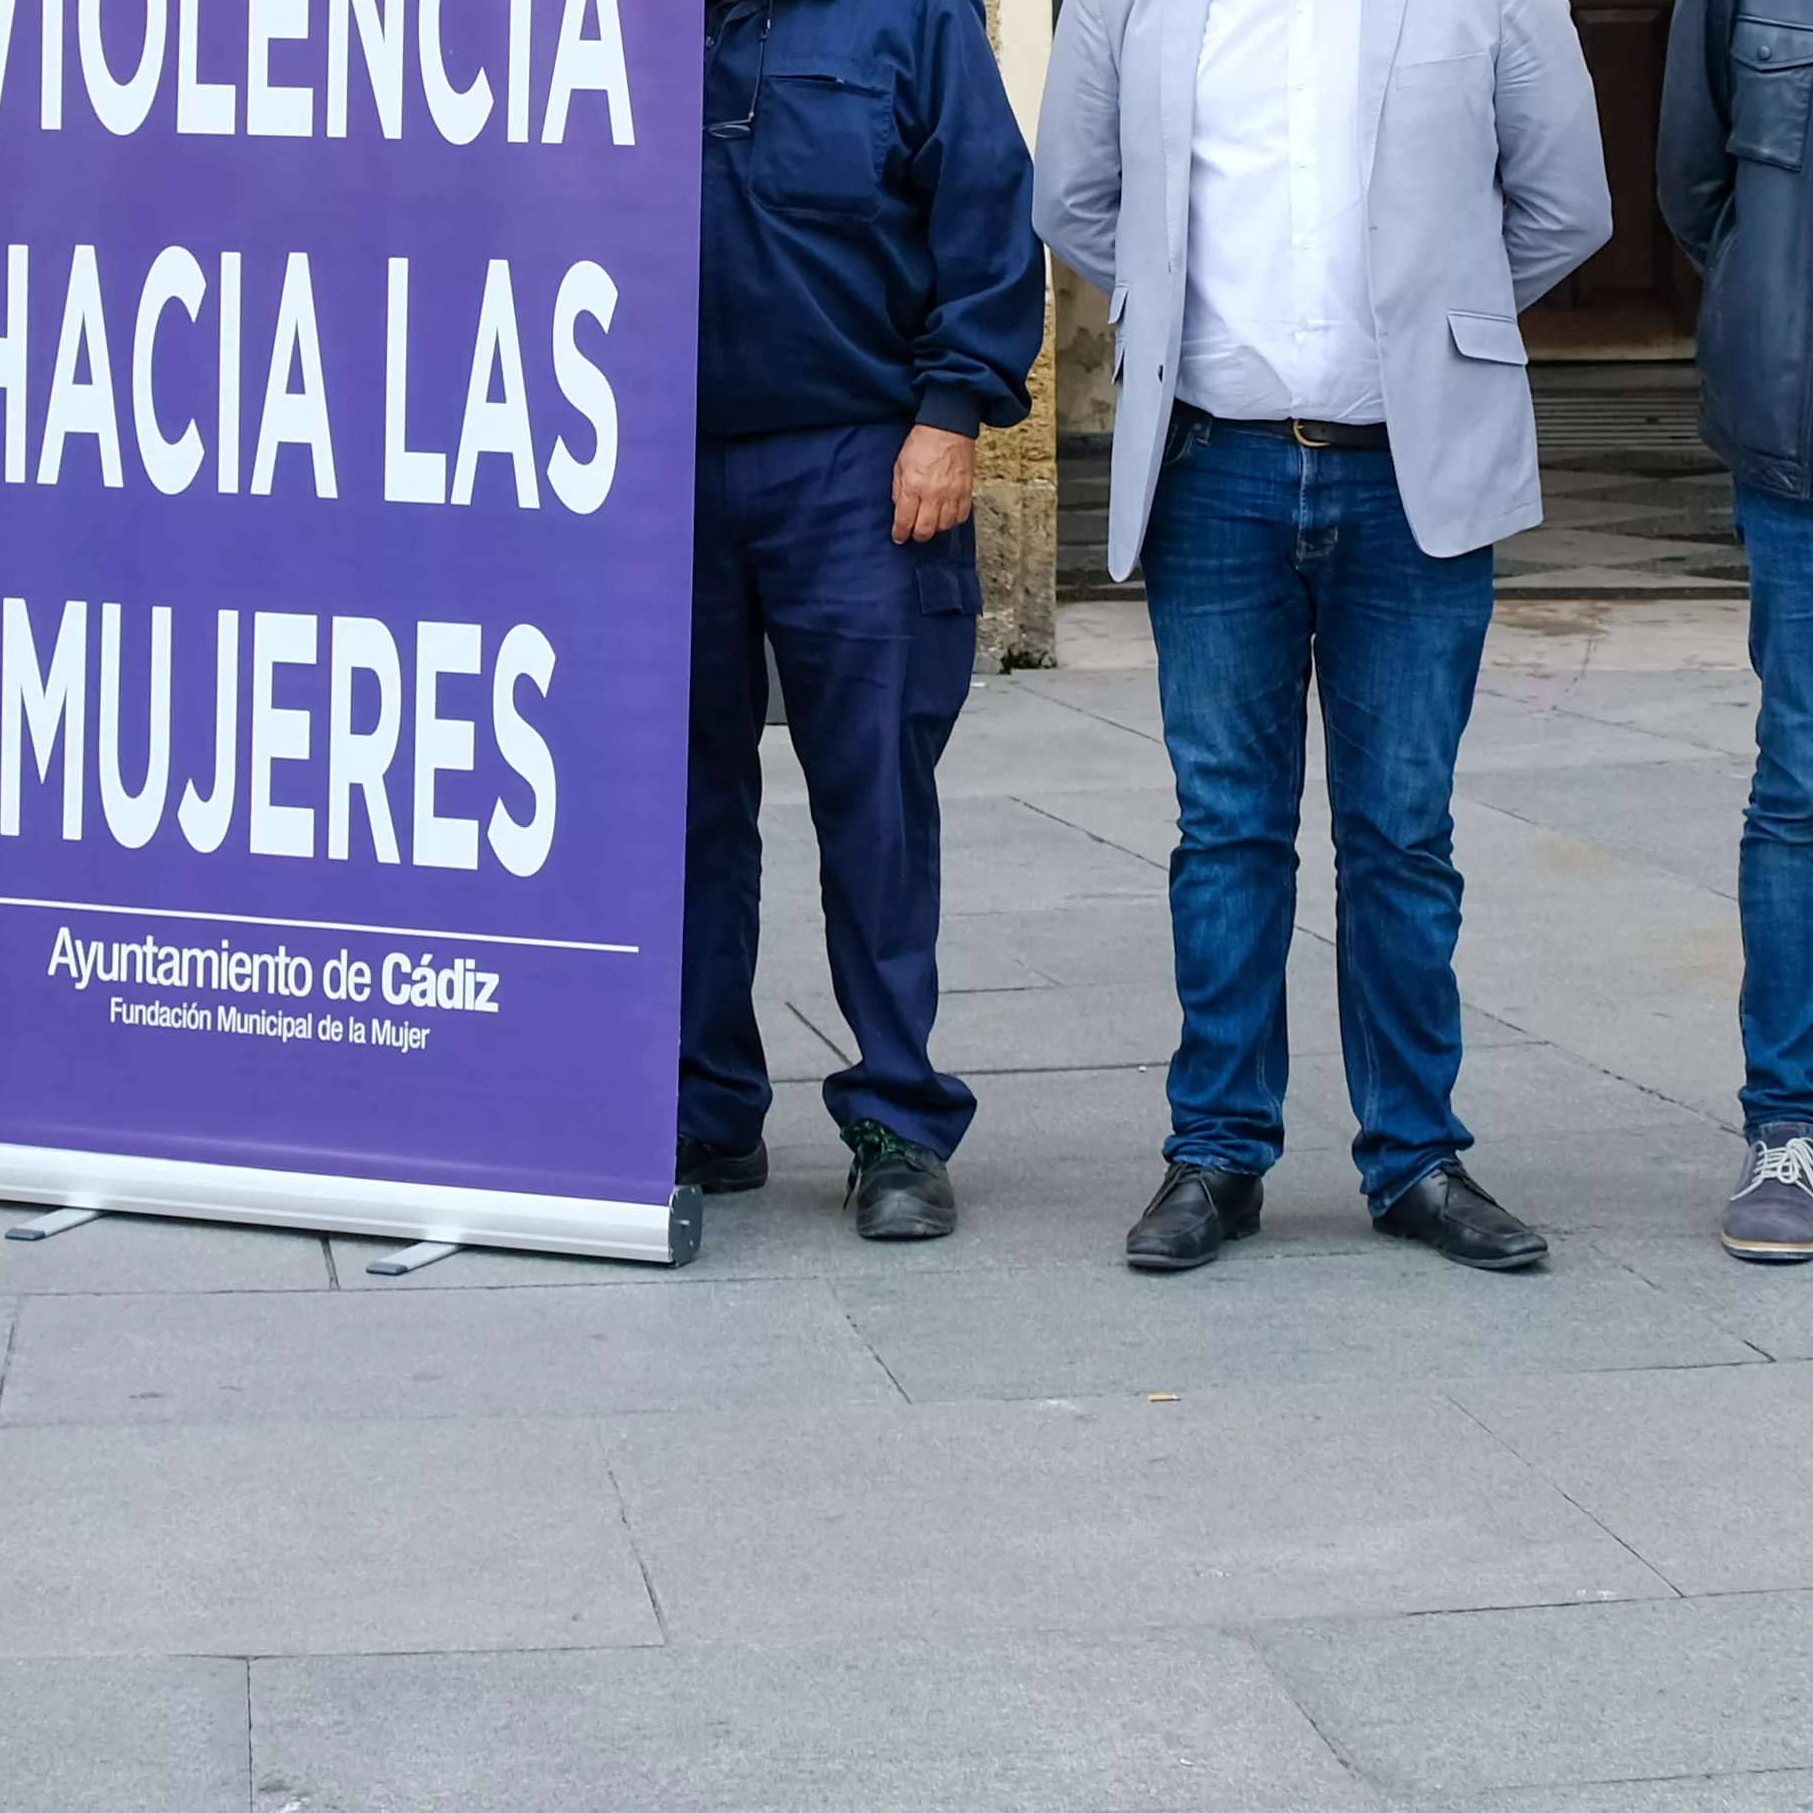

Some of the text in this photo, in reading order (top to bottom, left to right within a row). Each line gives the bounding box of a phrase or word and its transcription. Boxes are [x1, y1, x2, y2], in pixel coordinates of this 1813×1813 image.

[384, 257, 619, 515] LAS
[0, 597, 557, 877] MUJERES
[47, 926, 500, 1013] Ayuntamiento de Cádiz
[110, 996, 431, 1054] Fundación Municipal de la Mujer
